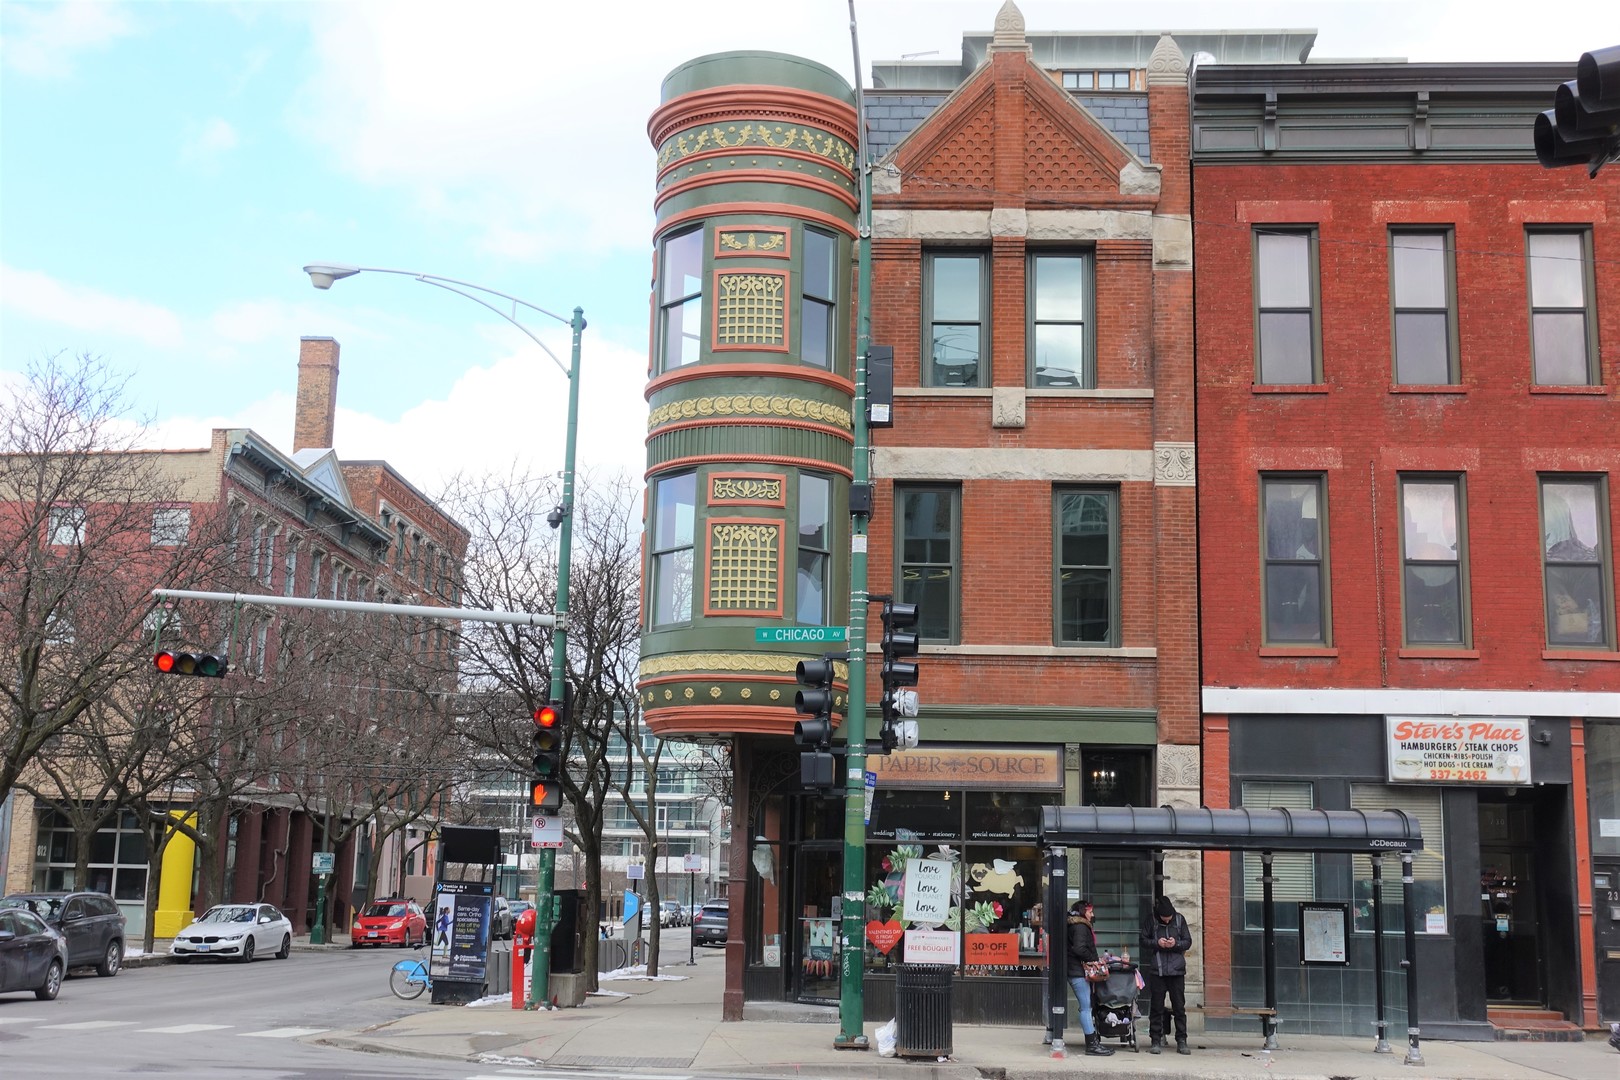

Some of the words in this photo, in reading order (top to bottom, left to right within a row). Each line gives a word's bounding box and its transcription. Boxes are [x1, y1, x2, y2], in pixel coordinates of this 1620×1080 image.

[775, 629, 824, 640] CHICAGO
[1394, 721, 1464, 740] Steve's
[1467, 723, 1525, 741] Place
[1491, 743, 1519, 752] CHOPS
[880, 756, 942, 773] PAPER
[967, 757, 1046, 774] SOURCE
[1430, 770, 1487, 780] 337-2462
[1608, 891, 1618, 900] 23
